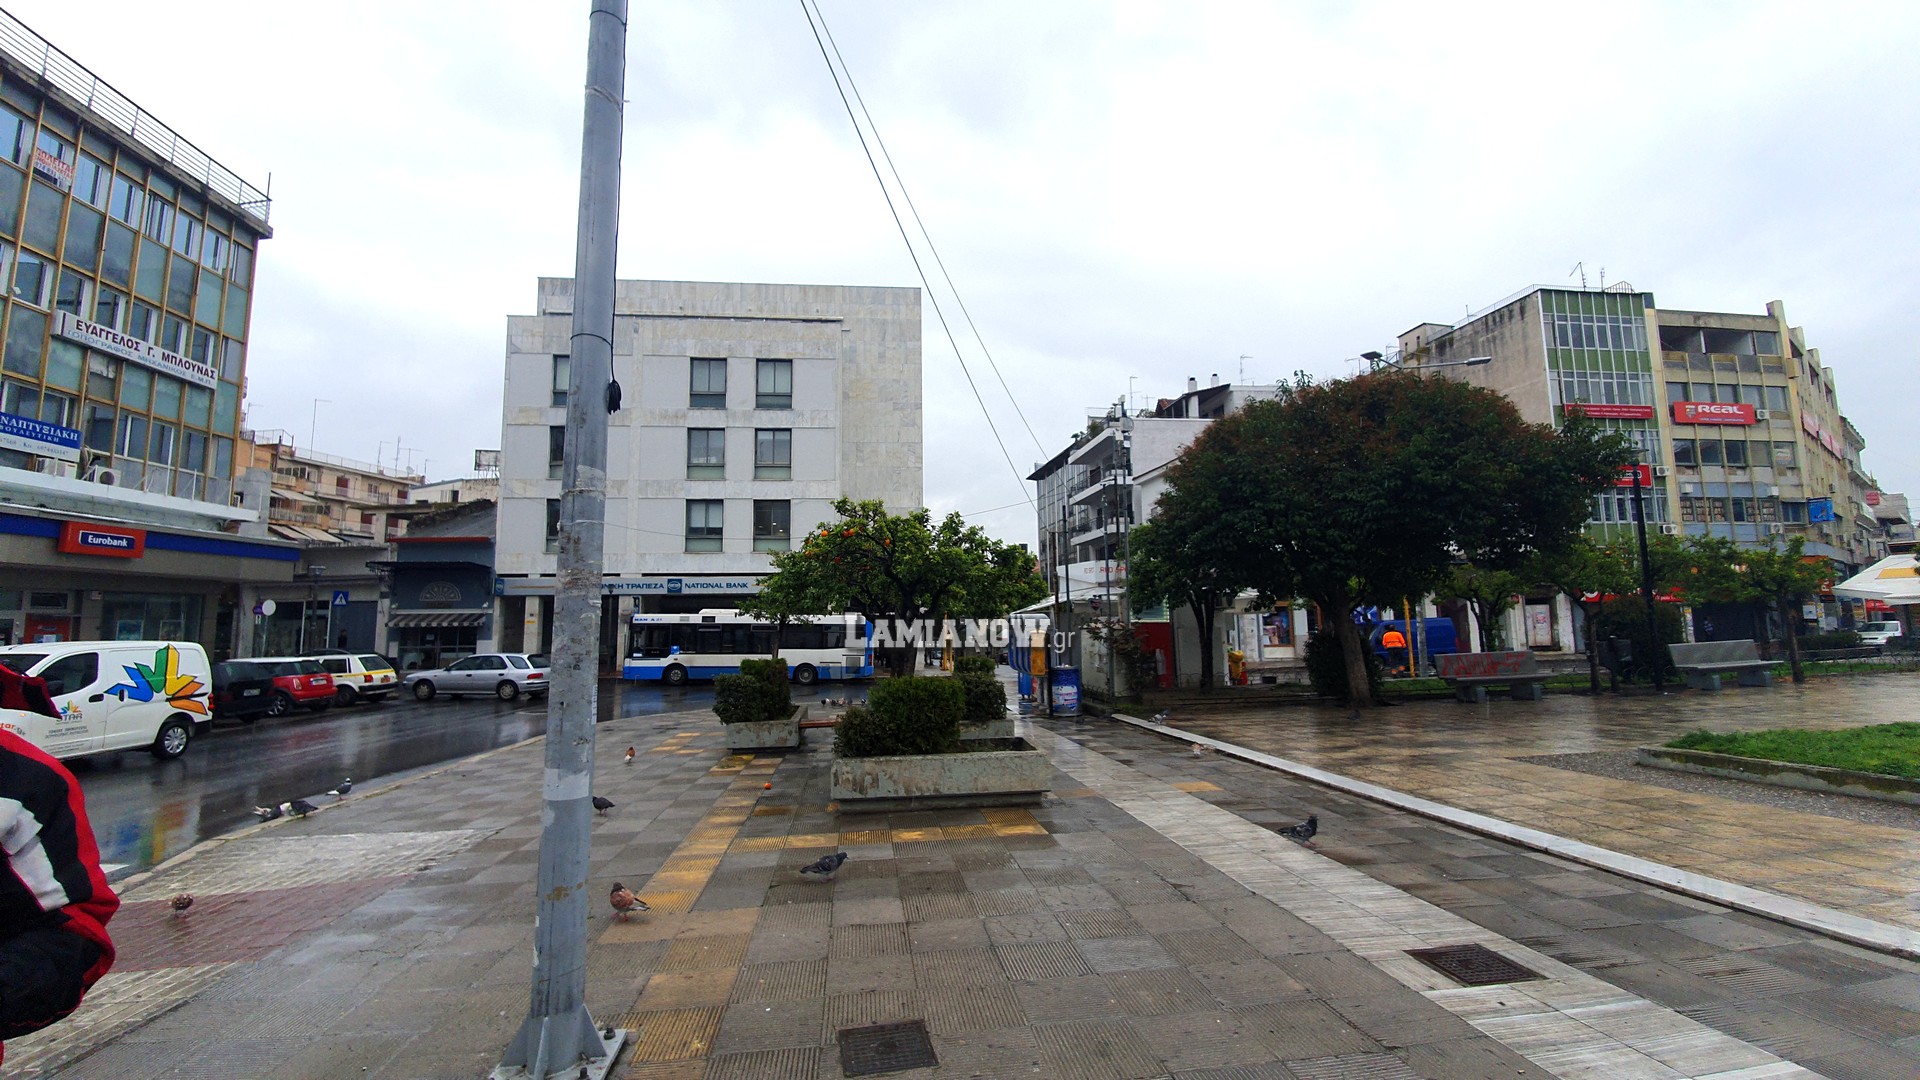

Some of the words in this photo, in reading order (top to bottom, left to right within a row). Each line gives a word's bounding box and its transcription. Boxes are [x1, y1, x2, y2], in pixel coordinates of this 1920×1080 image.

[76, 320, 141, 352] ΕΥΑΓΓΕΛΟΣ
[147, 346, 155, 358] Γ.
[162, 352, 216, 380] ΜΠΛΟΥΝΑΣ
[88, 535, 128, 547] Eurobank
[57, 712, 83, 722] TAR
